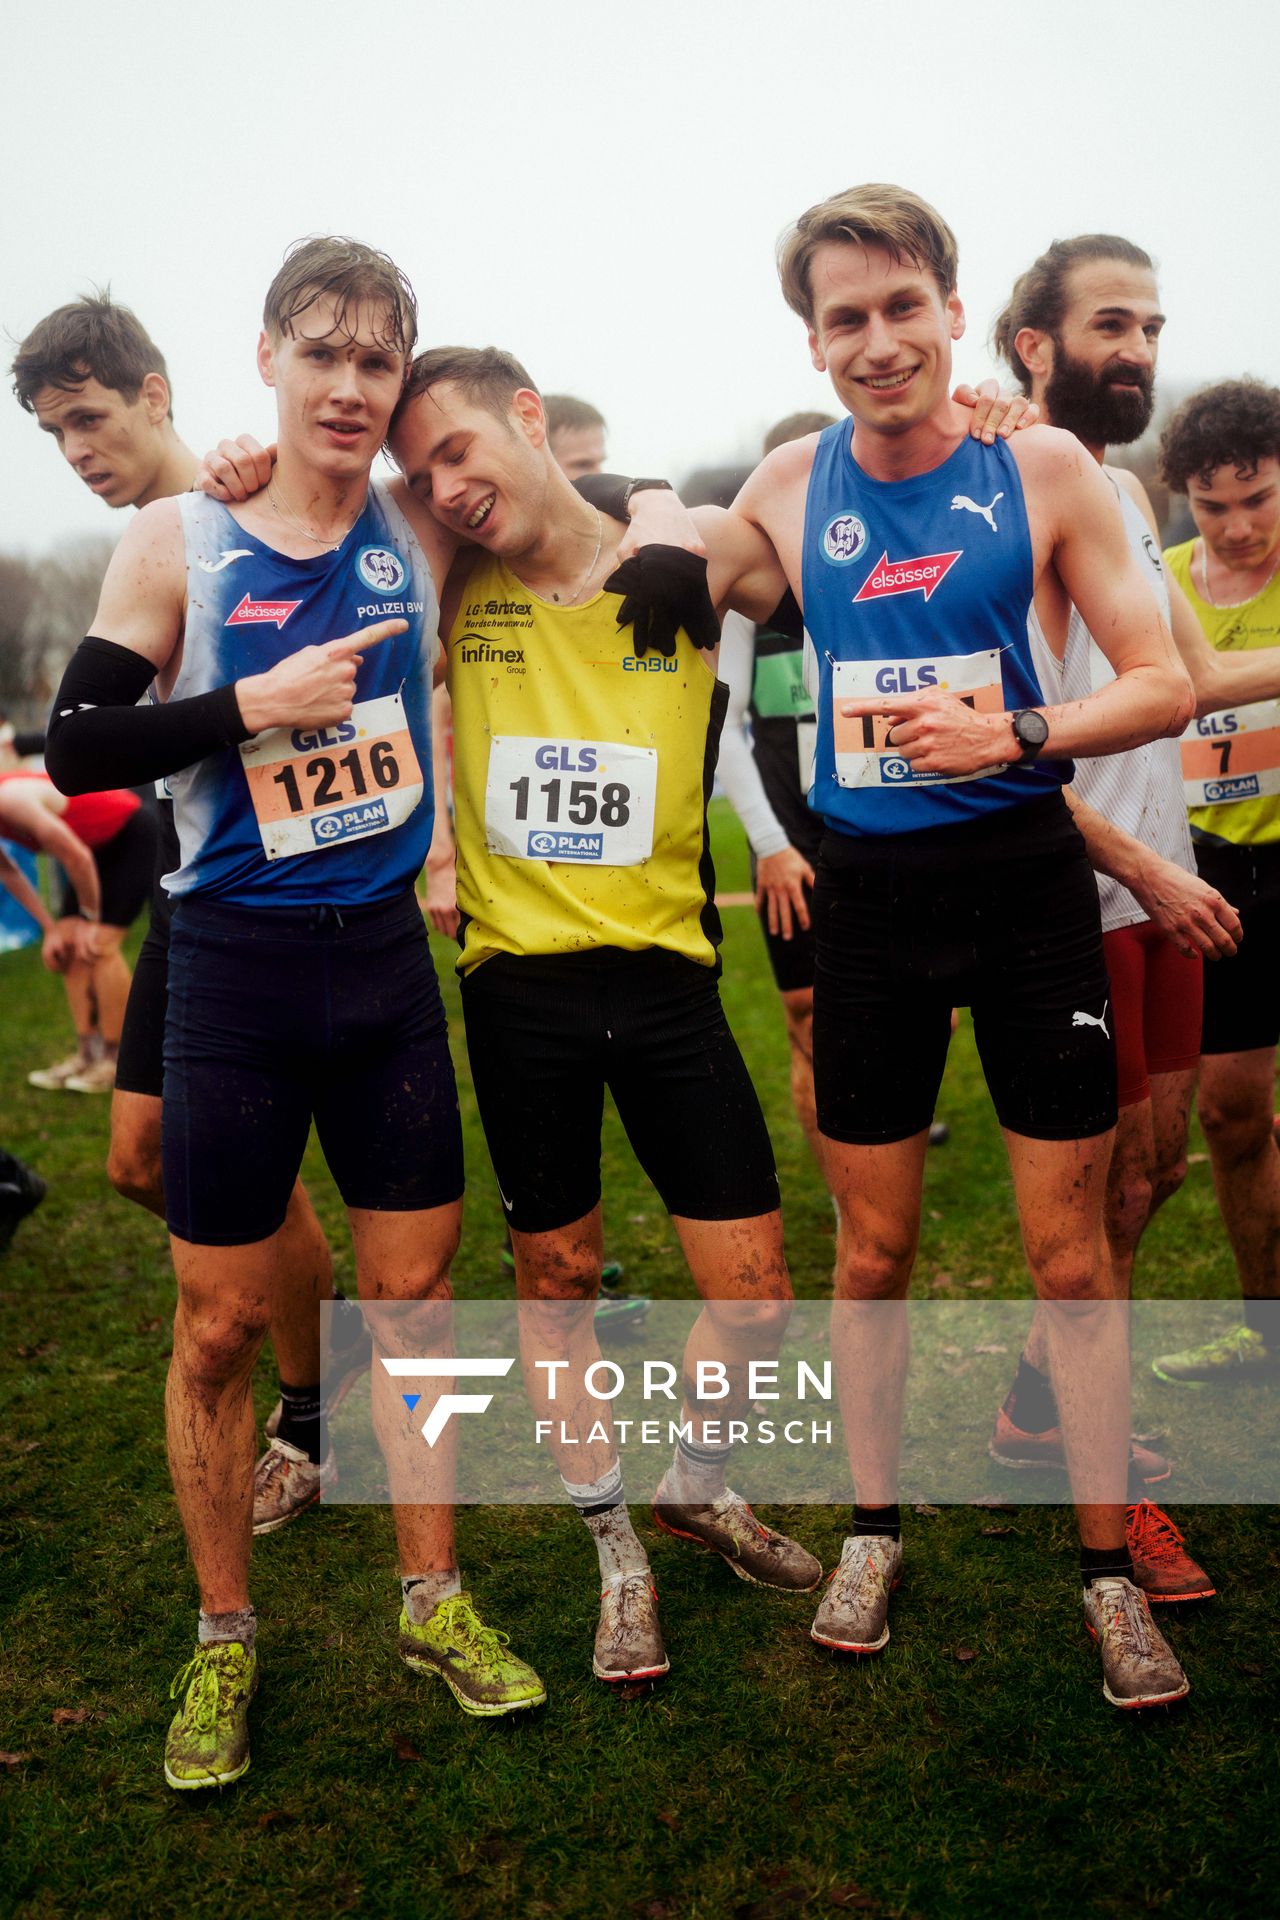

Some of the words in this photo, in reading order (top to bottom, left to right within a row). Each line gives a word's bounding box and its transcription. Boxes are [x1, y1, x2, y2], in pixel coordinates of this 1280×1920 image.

[871, 565, 941, 589] elsässer
[237, 605, 288, 618] elsässer
[357, 602, 405, 618] POLIZEI
[407, 602, 424, 613] BW
[461, 643, 525, 663] infinex
[506, 665, 527, 676] Group
[622, 656, 678, 673] EnBW
[1211, 740, 1232, 775] 7
[273, 740, 400, 813] 1216
[1224, 778, 1257, 793] PLAN
[509, 776, 631, 828] 1158
[342, 805, 385, 827] PLAN
[558, 836, 600, 850] PLAN
[558, 849, 599, 857] INTERNATIONAL
